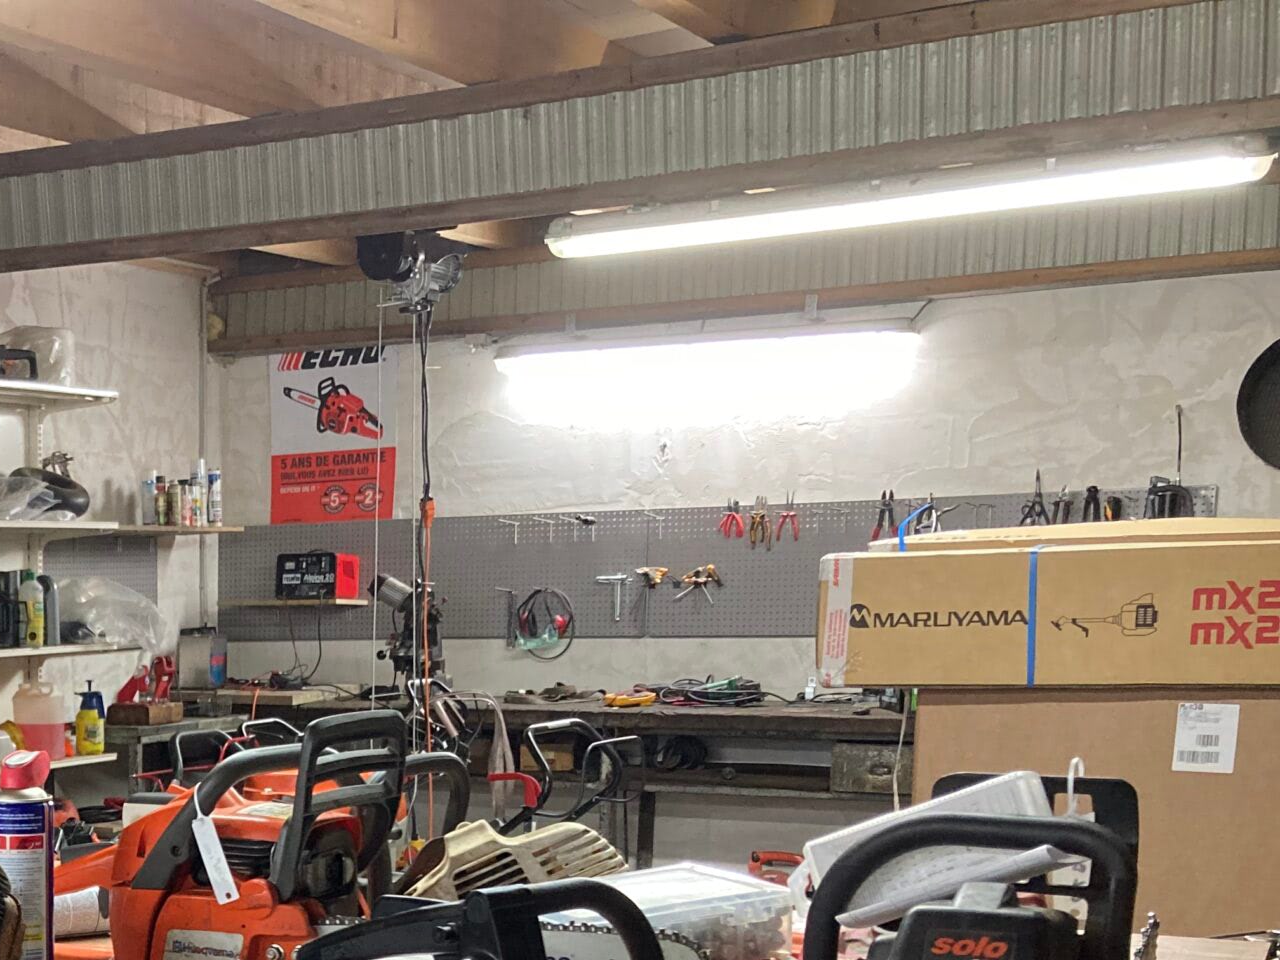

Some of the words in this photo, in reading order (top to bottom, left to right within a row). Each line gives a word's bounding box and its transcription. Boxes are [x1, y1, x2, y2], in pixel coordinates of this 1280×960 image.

[280, 458, 287, 469] 5
[290, 456, 312, 468] ANS
[316, 456, 329, 467] DE
[333, 451, 386, 465] GARANTE
[330, 492, 340, 507] 5
[363, 491, 374, 505] 2
[873, 609, 1029, 628] MARUYAMA
[930, 936, 1009, 959] solo
